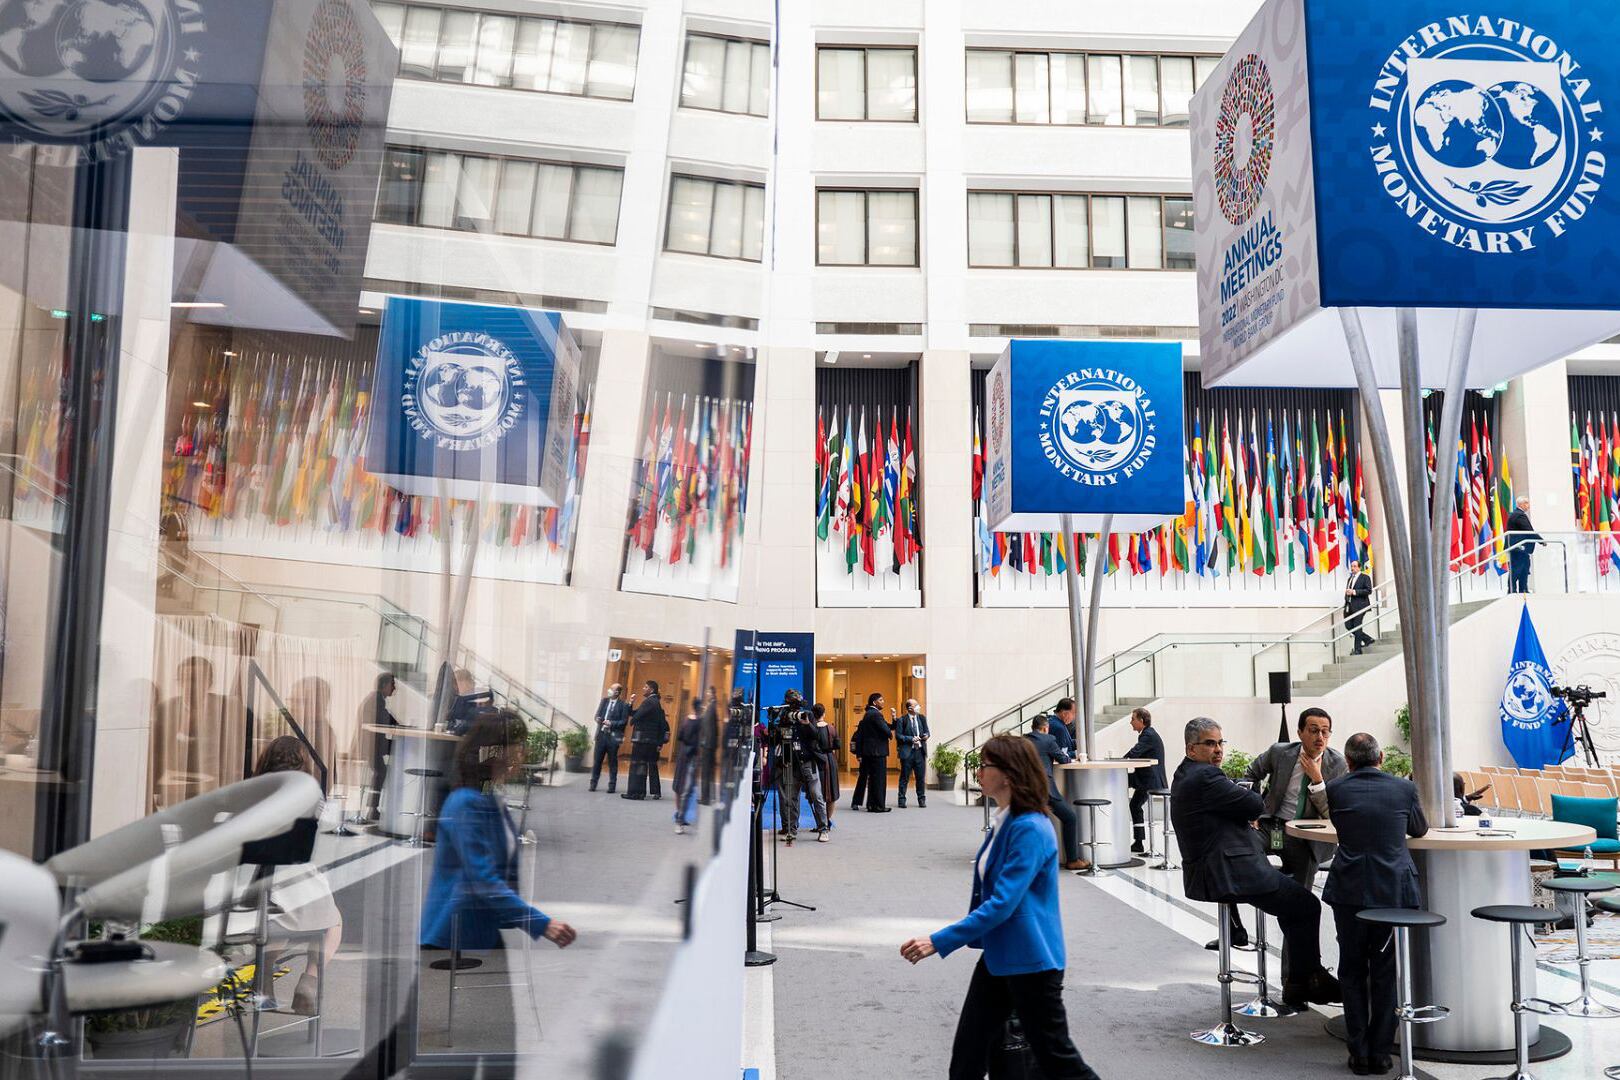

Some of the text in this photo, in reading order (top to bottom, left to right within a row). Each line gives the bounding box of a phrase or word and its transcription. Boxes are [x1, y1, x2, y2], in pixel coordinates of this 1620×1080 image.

[1369, 15, 1603, 122] INTERNATIONAL
[1369, 143, 1606, 253] MONETARY FUND
[1220, 231, 1283, 305] MEETINGS
[1224, 210, 1275, 275] ANNUAL
[1221, 303, 1237, 327] 2022
[1039, 367, 1156, 421] INTERNATIONAL
[1038, 432, 1119, 486] MONETARY
[1122, 434, 1156, 479] FUND
[1512, 720, 1542, 730] FUND
